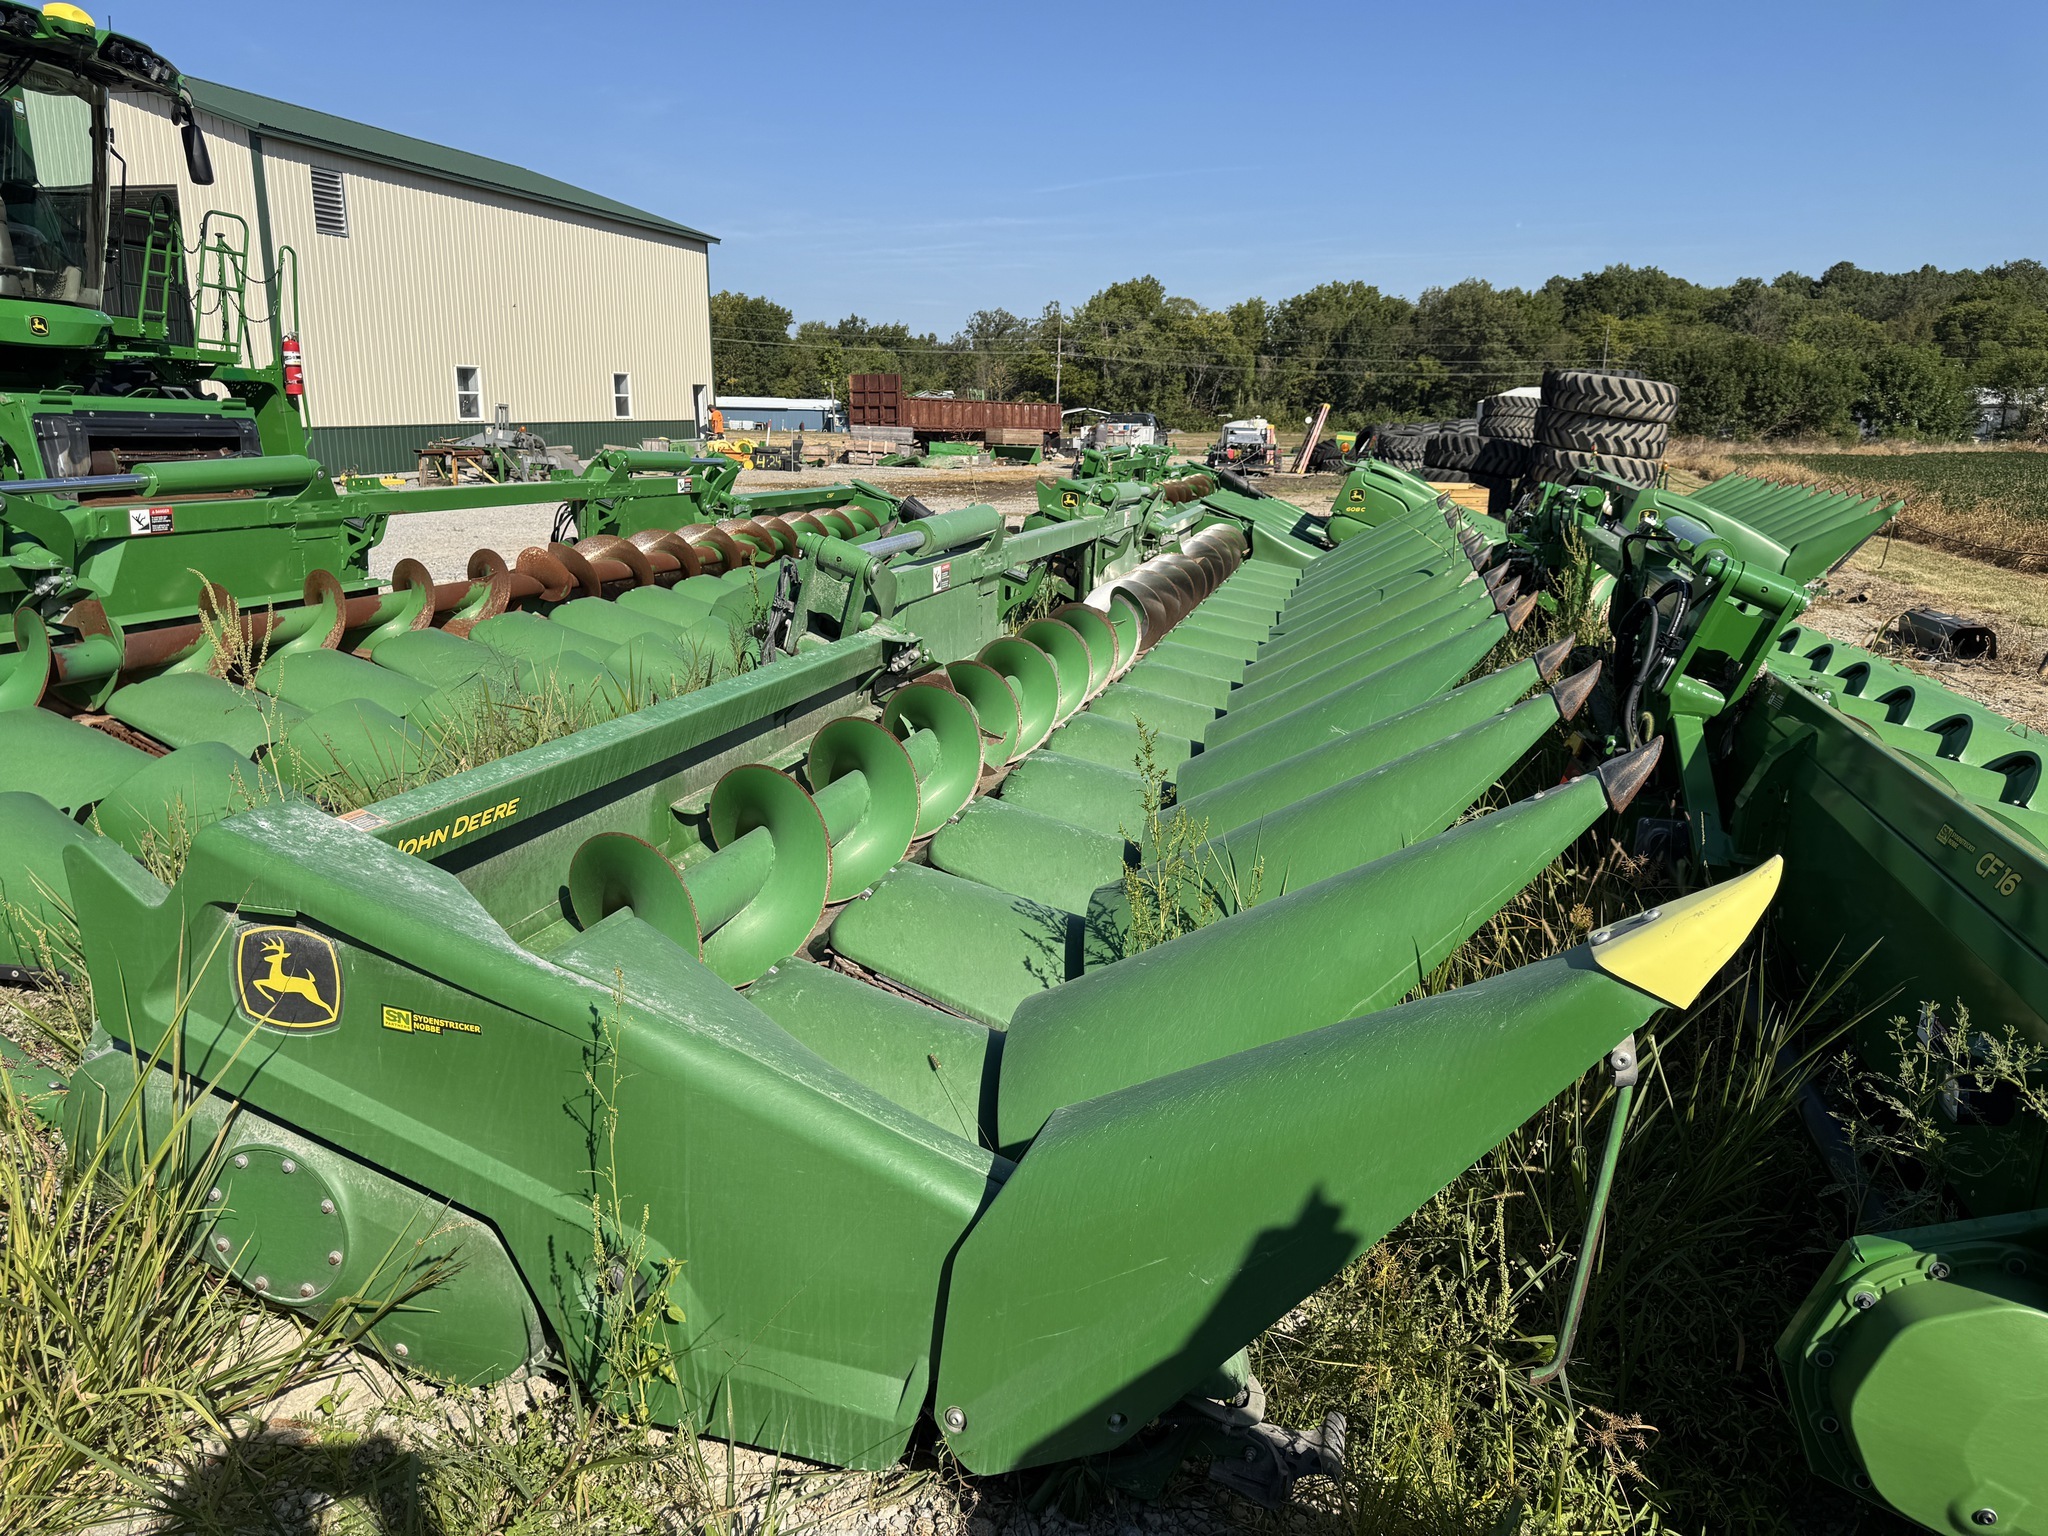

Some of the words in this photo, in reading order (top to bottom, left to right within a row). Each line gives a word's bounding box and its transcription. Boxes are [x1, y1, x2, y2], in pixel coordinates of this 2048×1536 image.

[452, 797, 520, 839] DEERE
[385, 1009, 410, 1026] SN
[413, 1014, 481, 1034] SYDENSTRICKER
[413, 1022, 441, 1034] NOBBE
